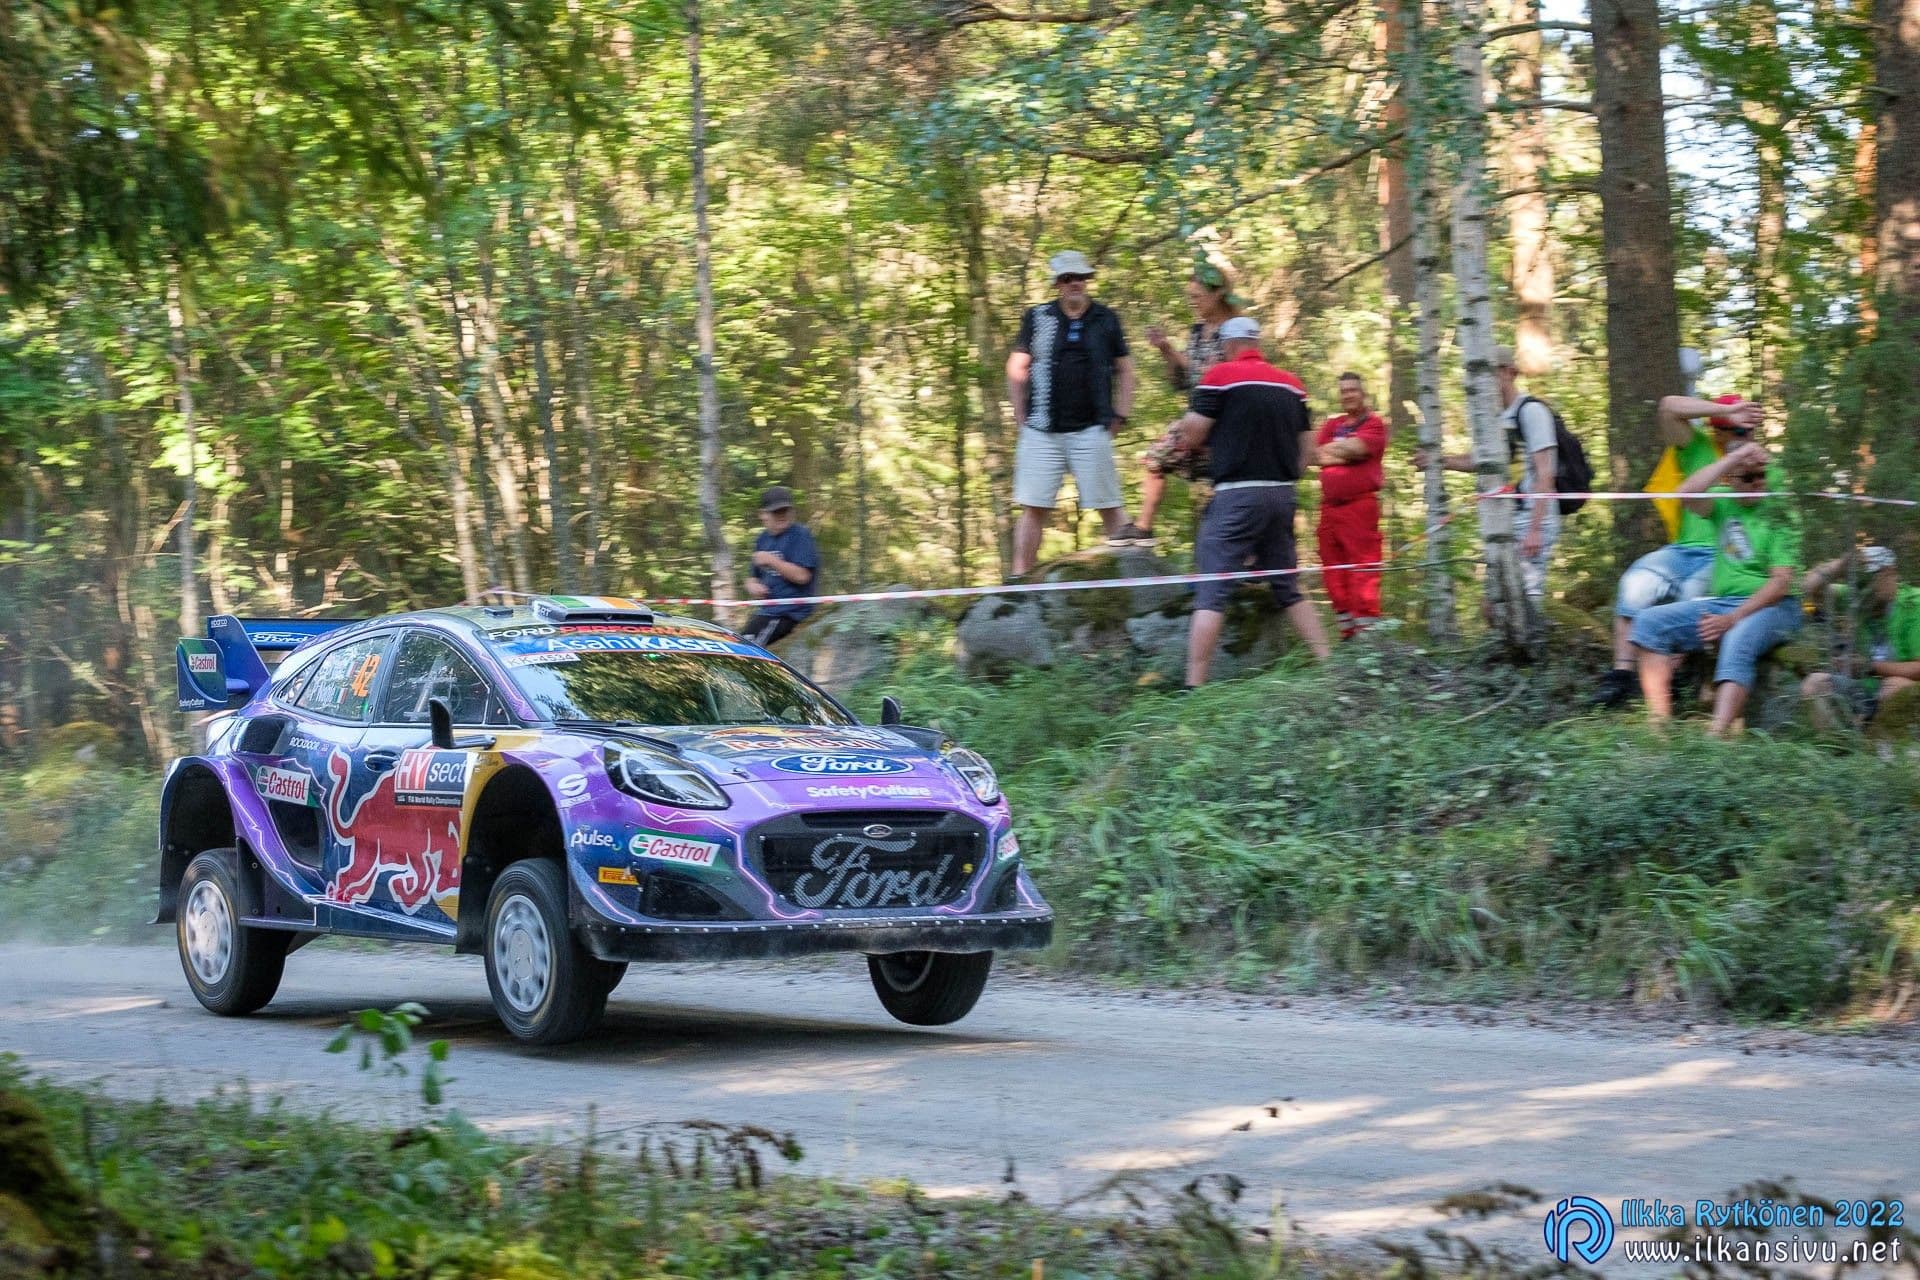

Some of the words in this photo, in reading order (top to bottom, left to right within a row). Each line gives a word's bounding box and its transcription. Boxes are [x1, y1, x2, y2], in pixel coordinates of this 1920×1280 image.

[488, 626, 556, 641] FORD
[547, 635, 735, 654] AsahiKASEI
[194, 655, 215, 671] Castrol
[799, 754, 892, 773] Ford
[268, 771, 306, 801] Castrol
[806, 784, 932, 800] SafetyCulture
[649, 838, 712, 863] Castrol
[793, 836, 954, 908] Ford
